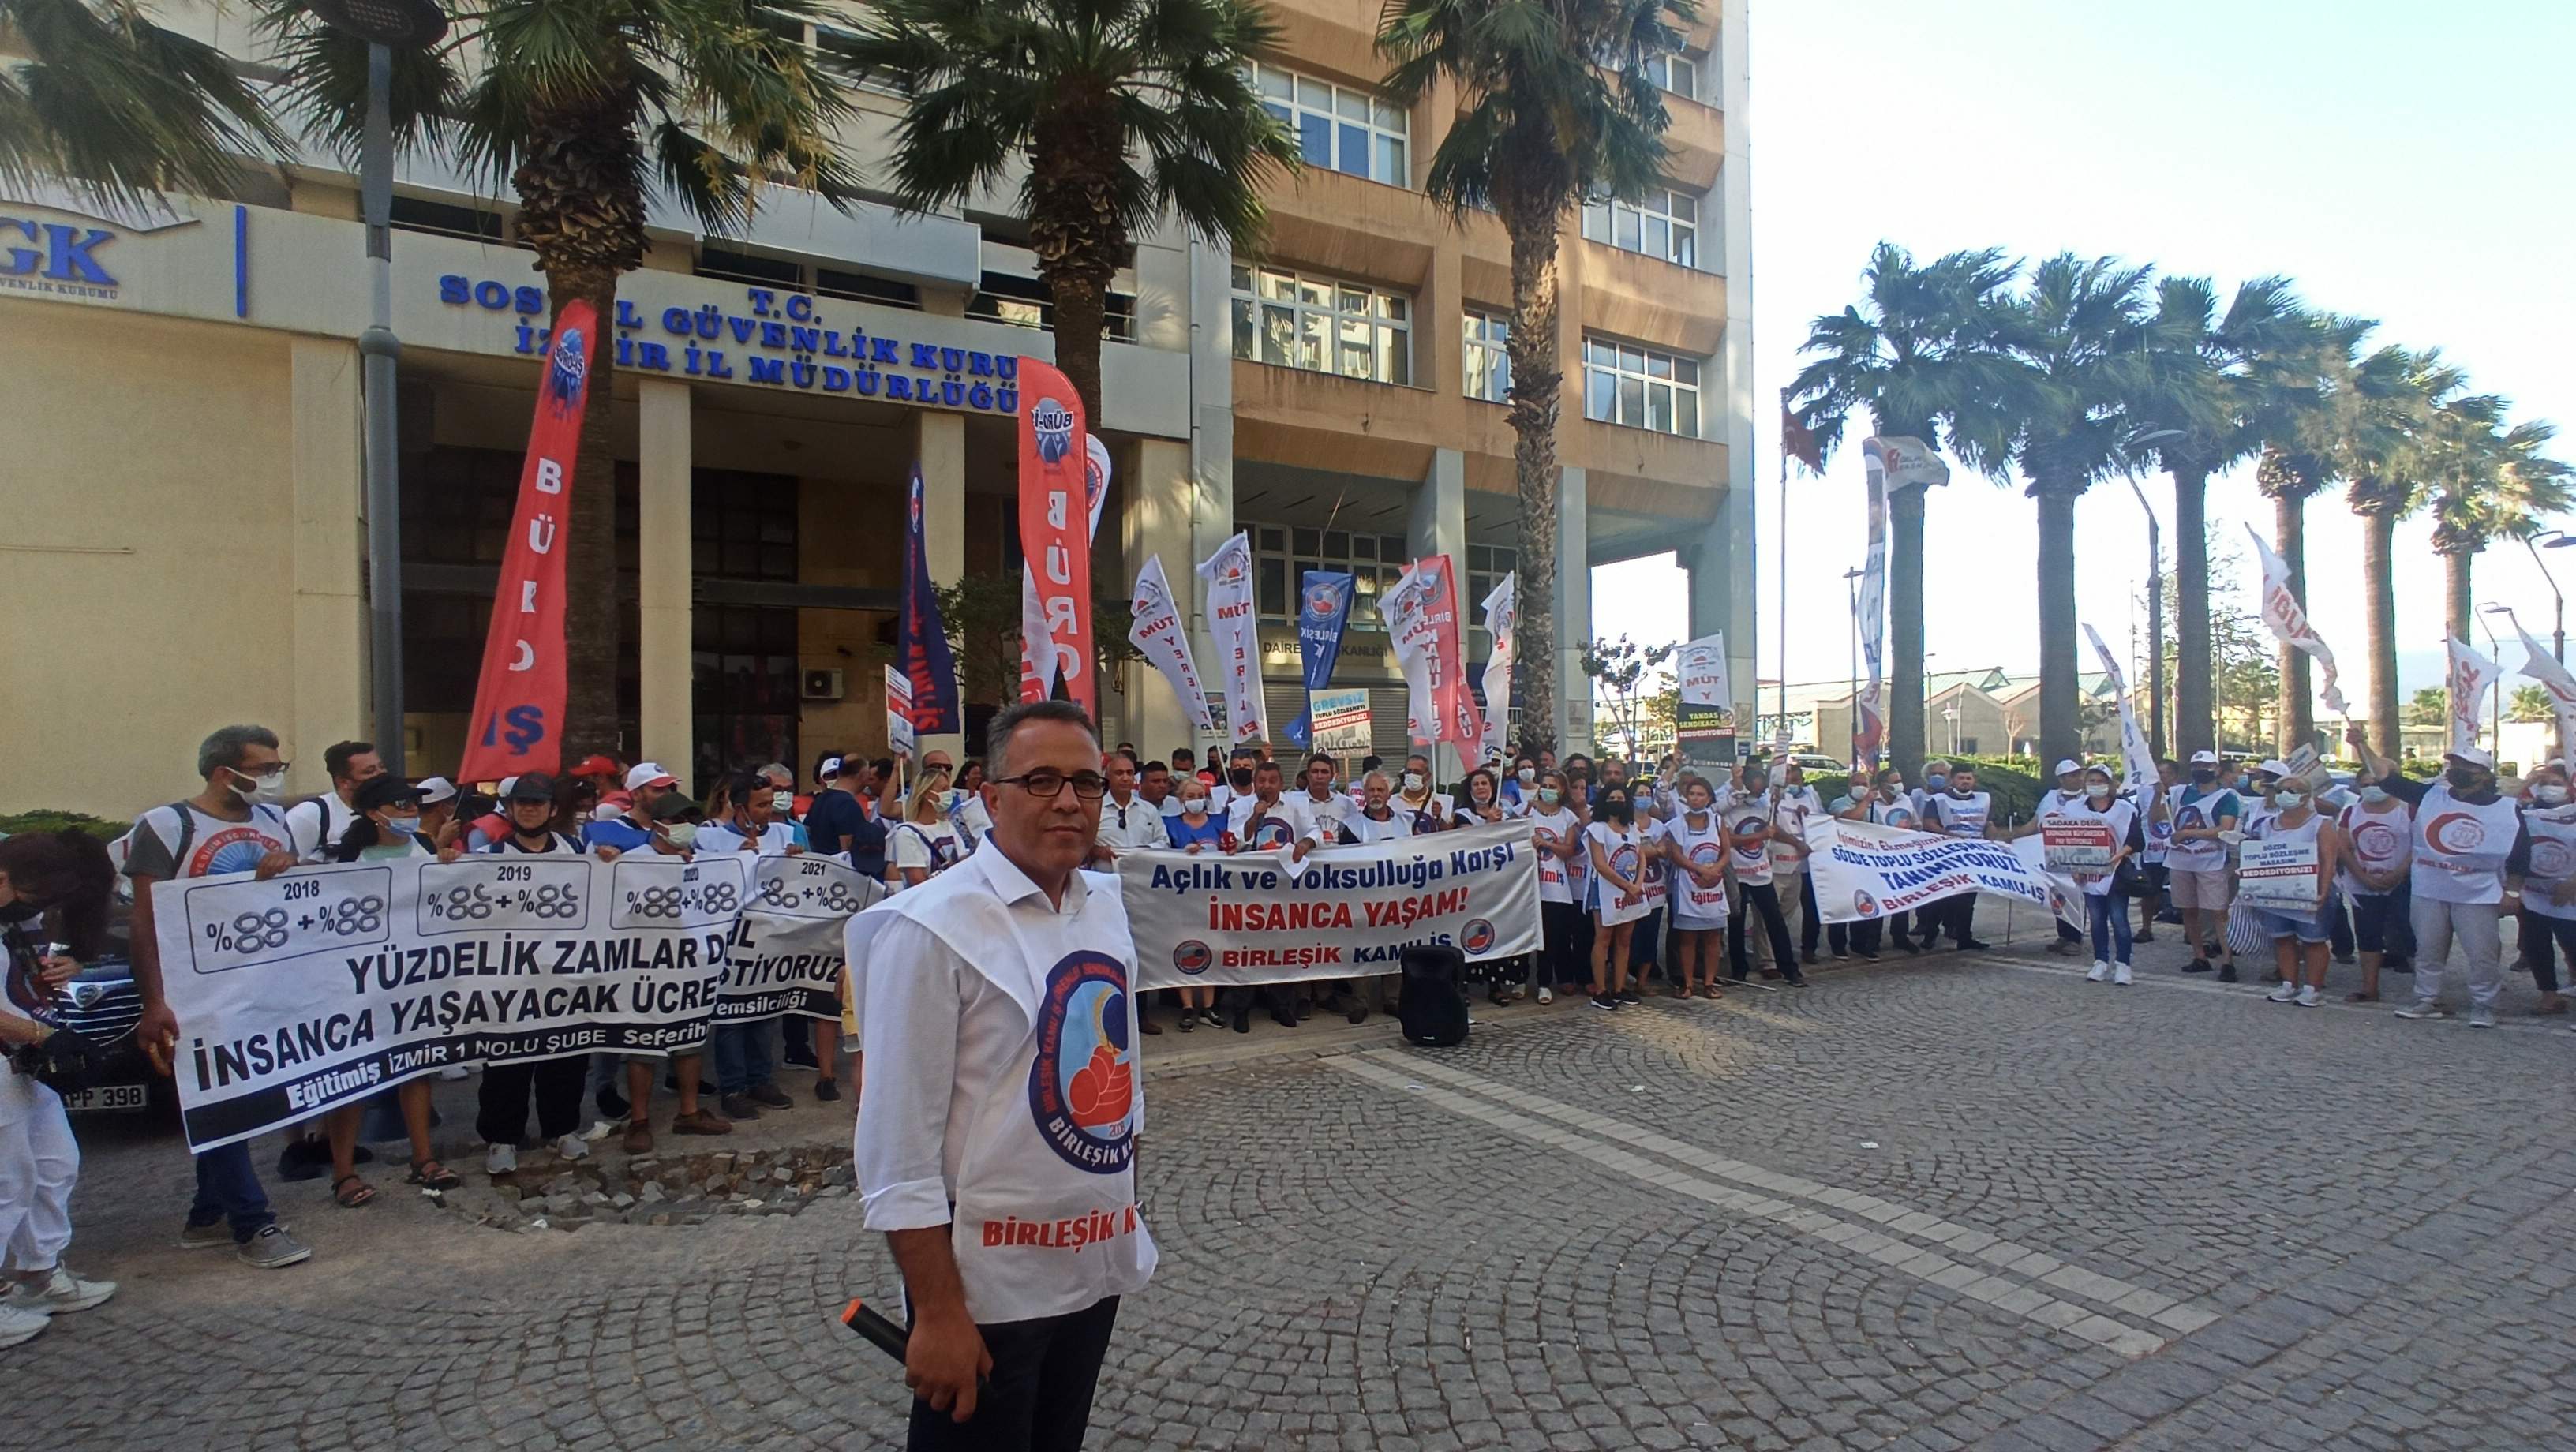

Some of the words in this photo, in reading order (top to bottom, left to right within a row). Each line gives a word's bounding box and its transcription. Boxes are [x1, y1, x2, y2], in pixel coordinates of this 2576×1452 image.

[58, 284, 118, 300] KURUMU
[748, 288, 822, 325] T.C.
[440, 275, 644, 330] SOSL
[662, 304, 900, 364] GÜVENLİK
[910, 342, 1018, 380] KURU
[685, 339, 732, 379] İL
[749, 354, 1019, 414] MÜDÜRLÜĞÜ
[1264, 641, 1301, 654] DAİRE
[1831, 844, 1870, 867] SÖZDE
[1869, 854, 1913, 868] TOPLU
[2244, 852, 2267, 861] TOPLU
[2263, 843, 2287, 851] SÖZDE
[497, 866, 532, 881] 2019
[801, 862, 827, 877] 2021
[1151, 863, 1233, 895] Açlık
[1241, 870, 1277, 890] ve
[1449, 842, 1515, 875] Karşı
[1879, 852, 2027, 891] TANIMIYORUZ!
[283, 880, 320, 901] 2018
[1209, 895, 1353, 931] İNSANCA
[1363, 886, 1469, 930] YAŞAM!
[1881, 873, 1975, 911] BİRLEŞİK
[1976, 874, 2046, 906] KAMU-İŞ
[346, 932, 542, 995] YÜZDELİK
[552, 937, 698, 975] ZAMLAR
[1222, 942, 1342, 969] BİRLEŞİK
[193, 1009, 375, 1092] İNSANCA
[391, 982, 621, 1035] YAŞAYACAK
[632, 975, 718, 1014] ÜCRE
[286, 1061, 381, 1110] Eğitimiş
[388, 1043, 447, 1074] İZMİR
[475, 1037, 540, 1057] NOLU
[545, 1029, 608, 1054] ŞUBE
[716, 990, 809, 1016] emsilciliği
[103, 1087, 142, 1106] 398
[1048, 1115, 1119, 1167] BİRLEŞİK
[983, 1209, 1116, 1254] BİRLEŞİK
